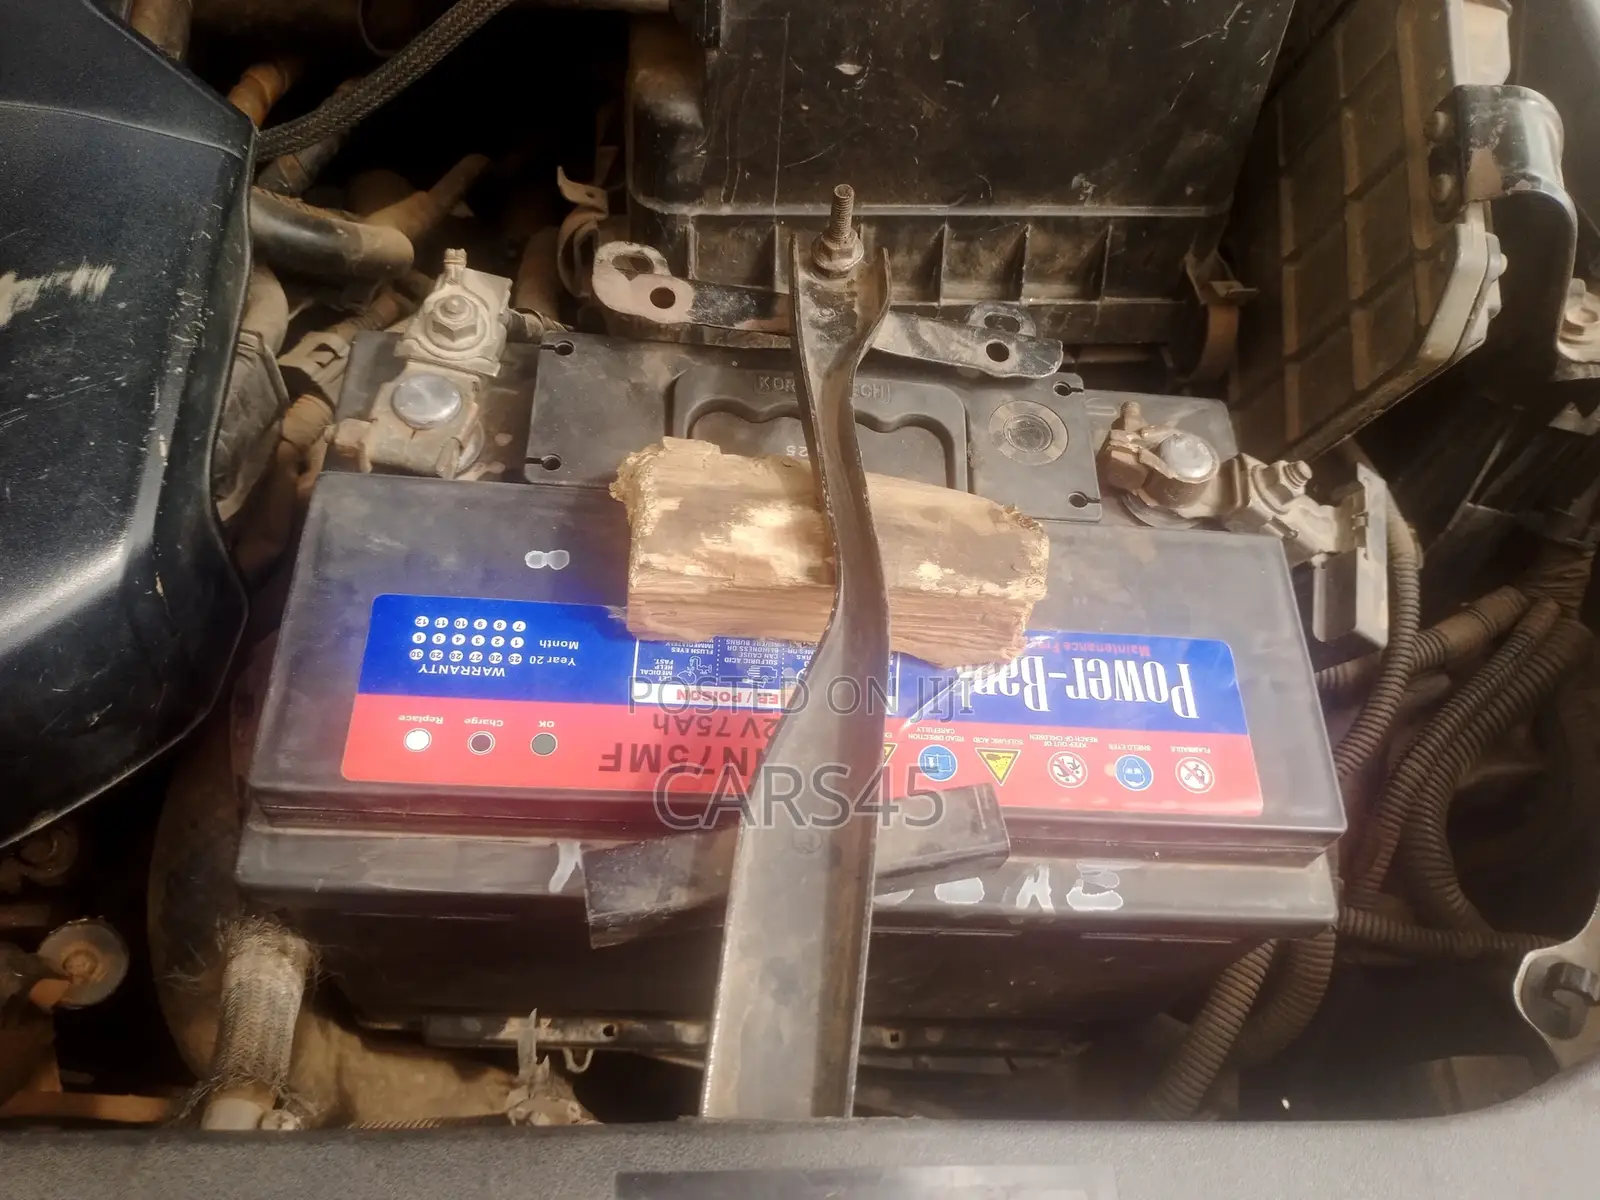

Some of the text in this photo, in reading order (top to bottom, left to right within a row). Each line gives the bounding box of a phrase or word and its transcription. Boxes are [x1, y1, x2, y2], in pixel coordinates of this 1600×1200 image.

[539, 639, 579, 650] Month
[1063, 641, 1151, 656] Maintenance
[529, 655, 544, 664] 20
[547, 656, 576, 666] Year
[743, 658, 778, 666] SULFURIC
[418, 664, 506, 677] WARRANTY
[676, 689, 743, 703] POISON
[398, 714, 444, 724] Replace
[464, 717, 504, 727] Charge
[538, 720, 555, 728] OK
[653, 713, 781, 740] 2V 75Ah
